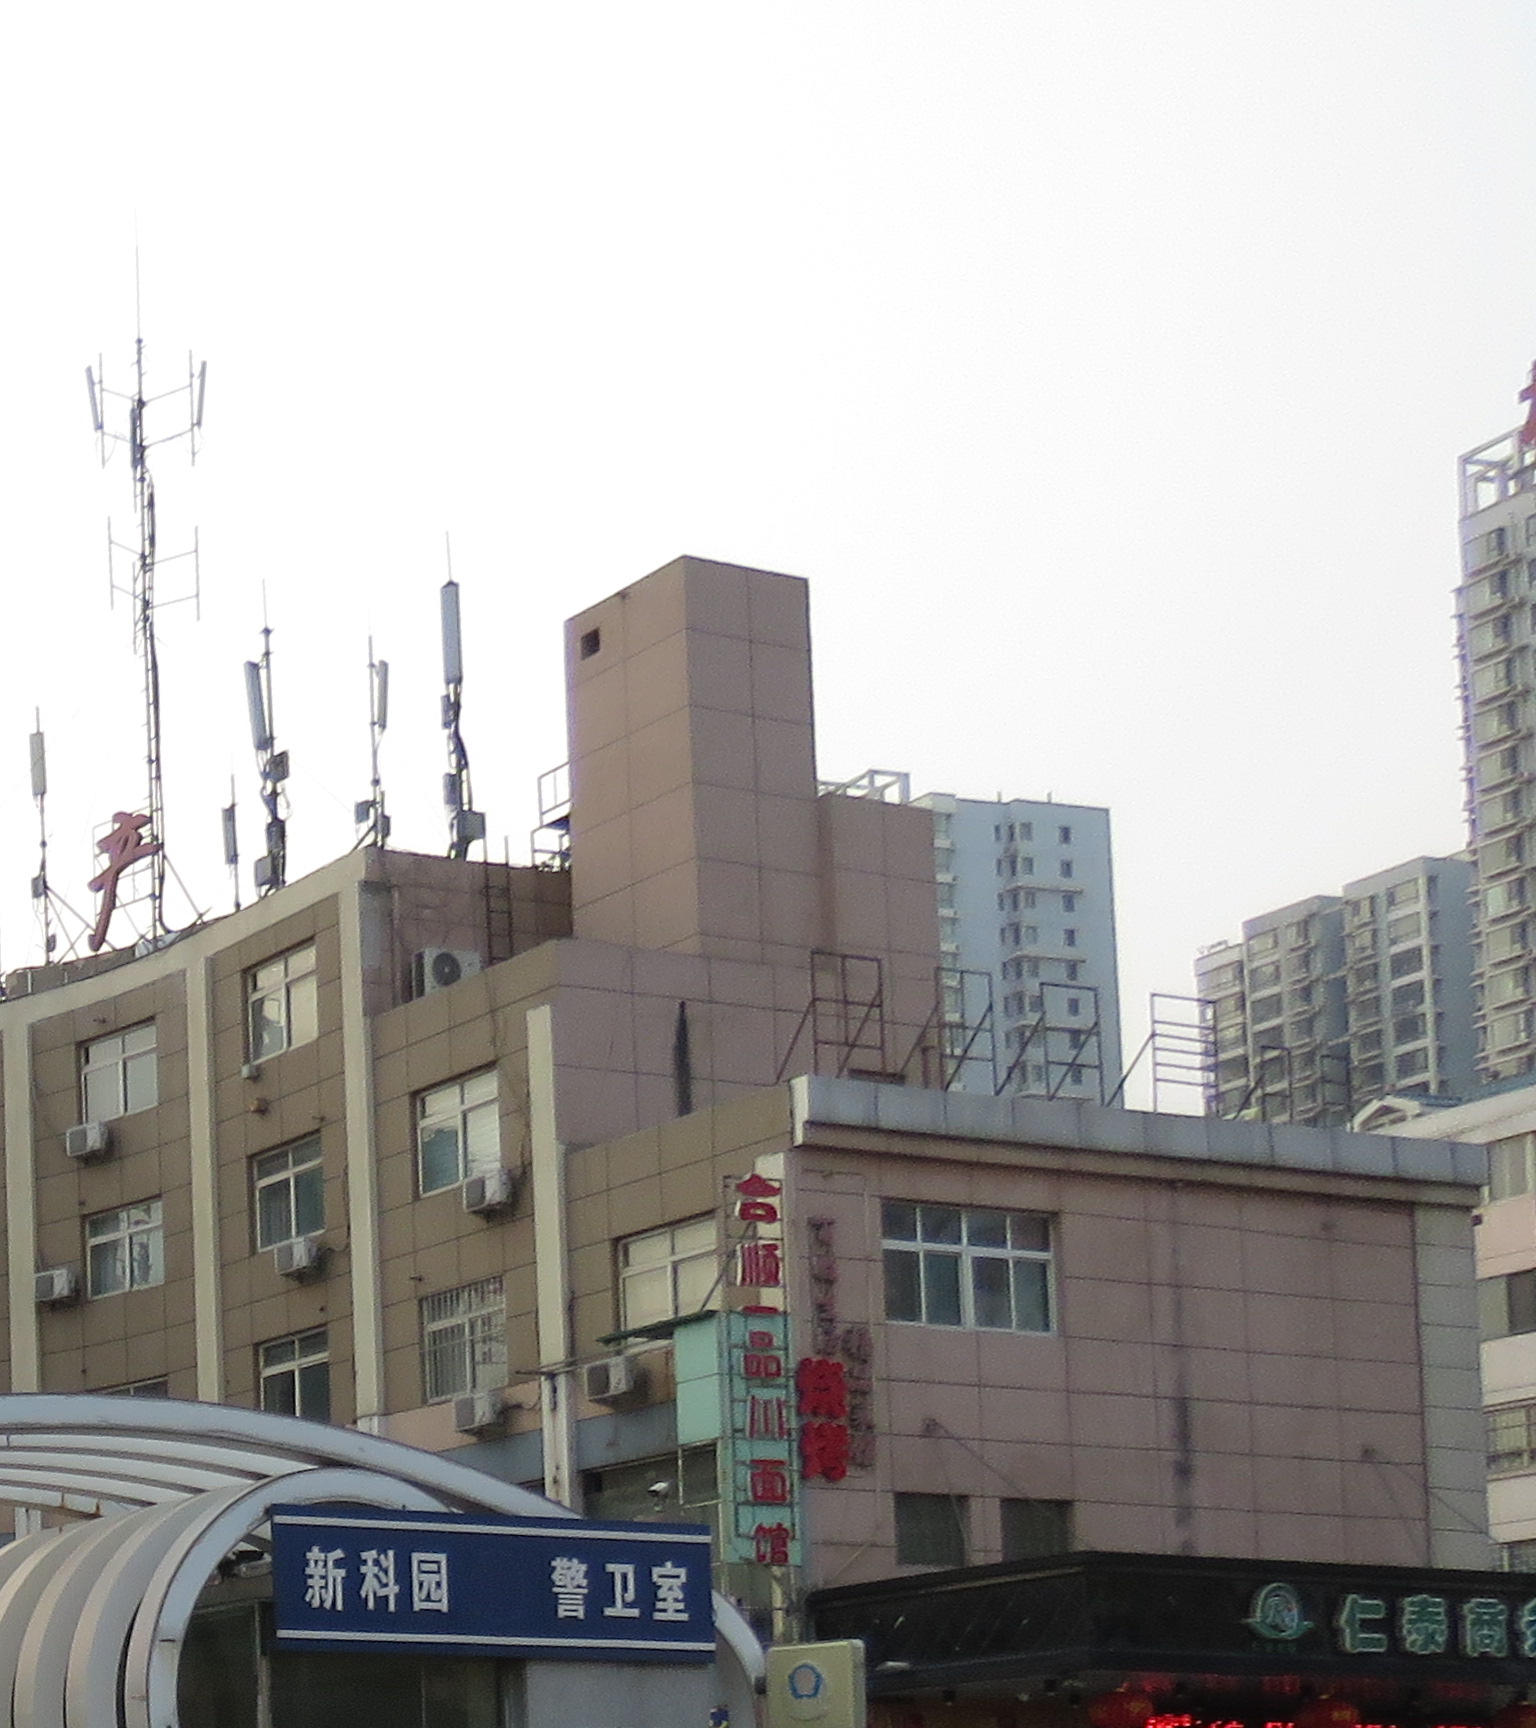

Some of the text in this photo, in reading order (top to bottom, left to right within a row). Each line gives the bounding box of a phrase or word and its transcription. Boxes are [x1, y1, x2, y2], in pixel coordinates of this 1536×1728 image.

[303, 1545, 690, 1622] 新科园 警卫室
